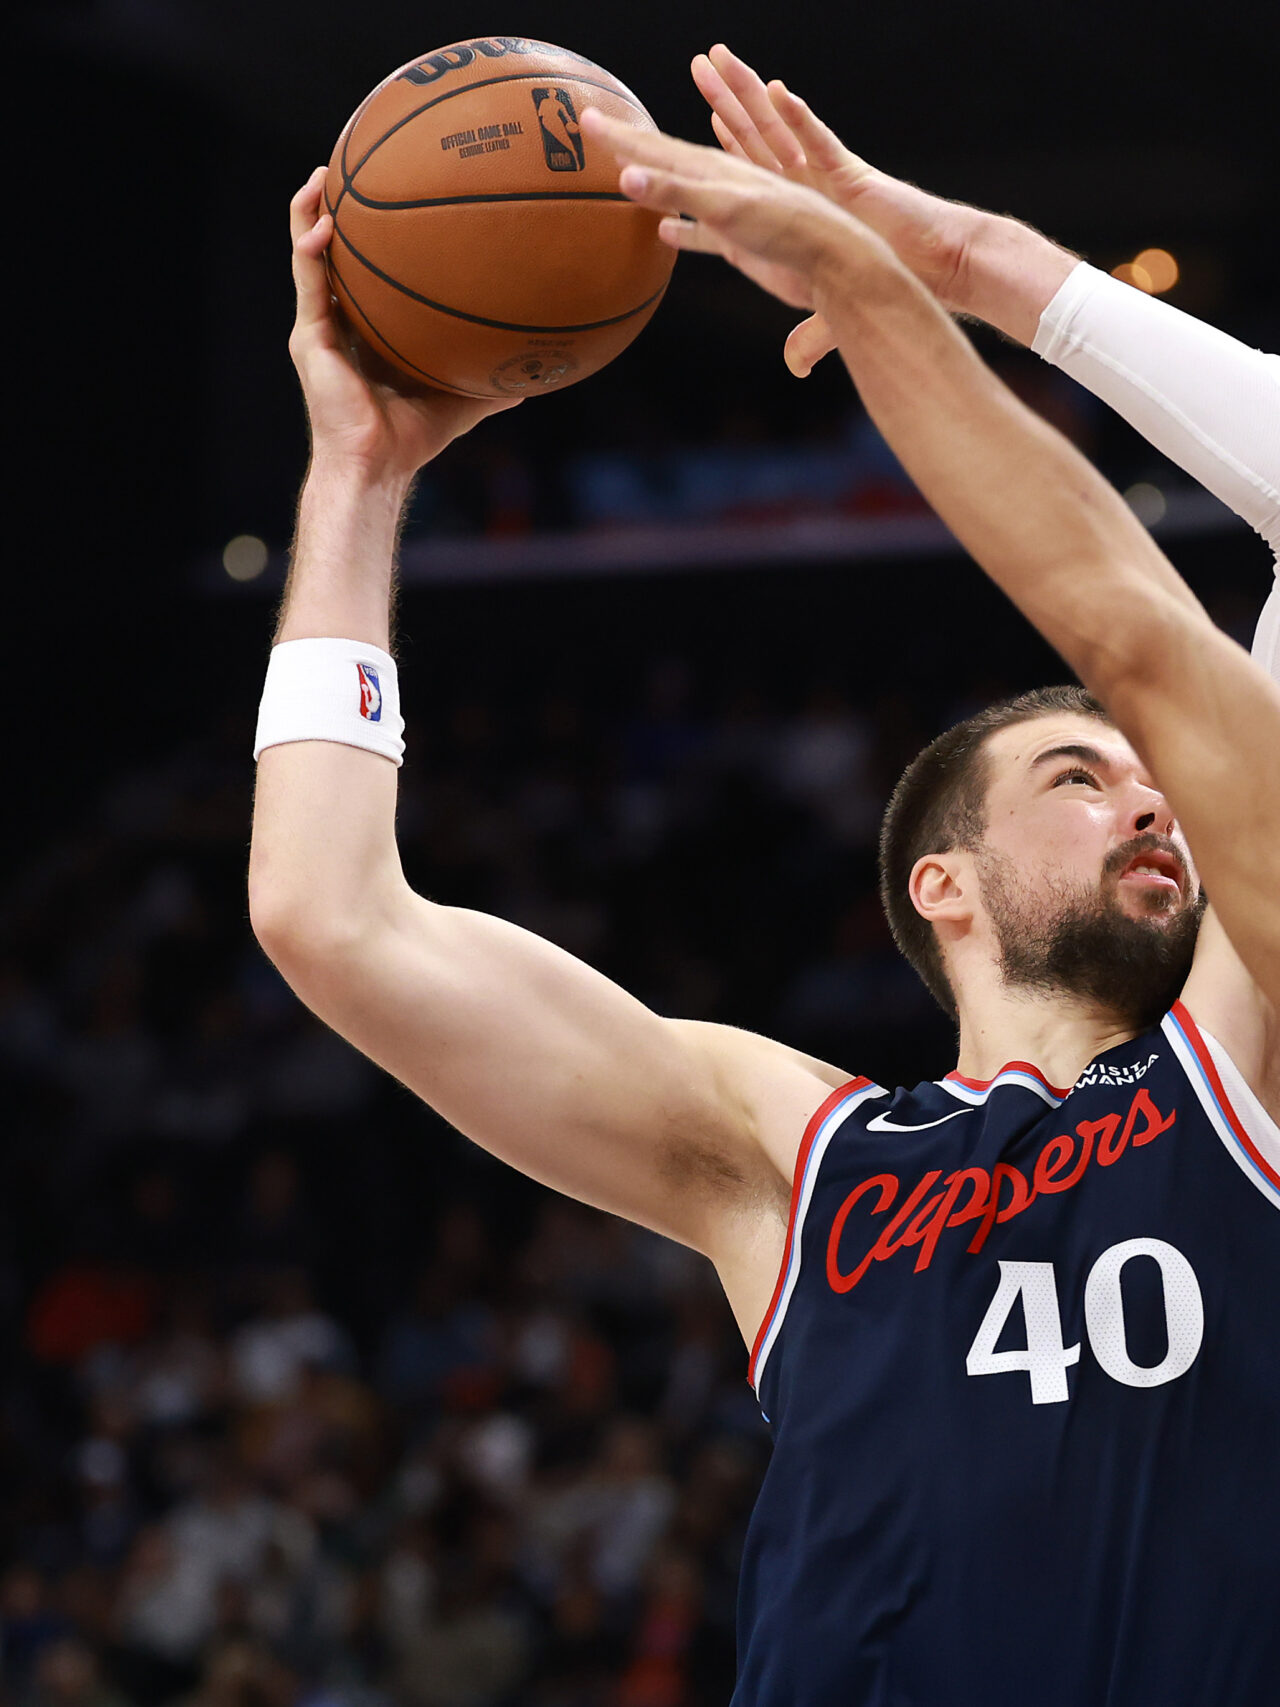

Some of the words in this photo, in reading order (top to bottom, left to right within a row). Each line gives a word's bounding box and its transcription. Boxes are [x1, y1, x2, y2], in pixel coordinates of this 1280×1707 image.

[440, 129, 478, 151] OFFICIAL
[478, 124, 503, 141] GAME
[502, 121, 524, 137] BALL
[485, 138, 510, 154] LEATHER
[1083, 1060, 1141, 1076] VISIT
[825, 1087, 1177, 1294] Clippers
[966, 1236, 1205, 1405] 40
